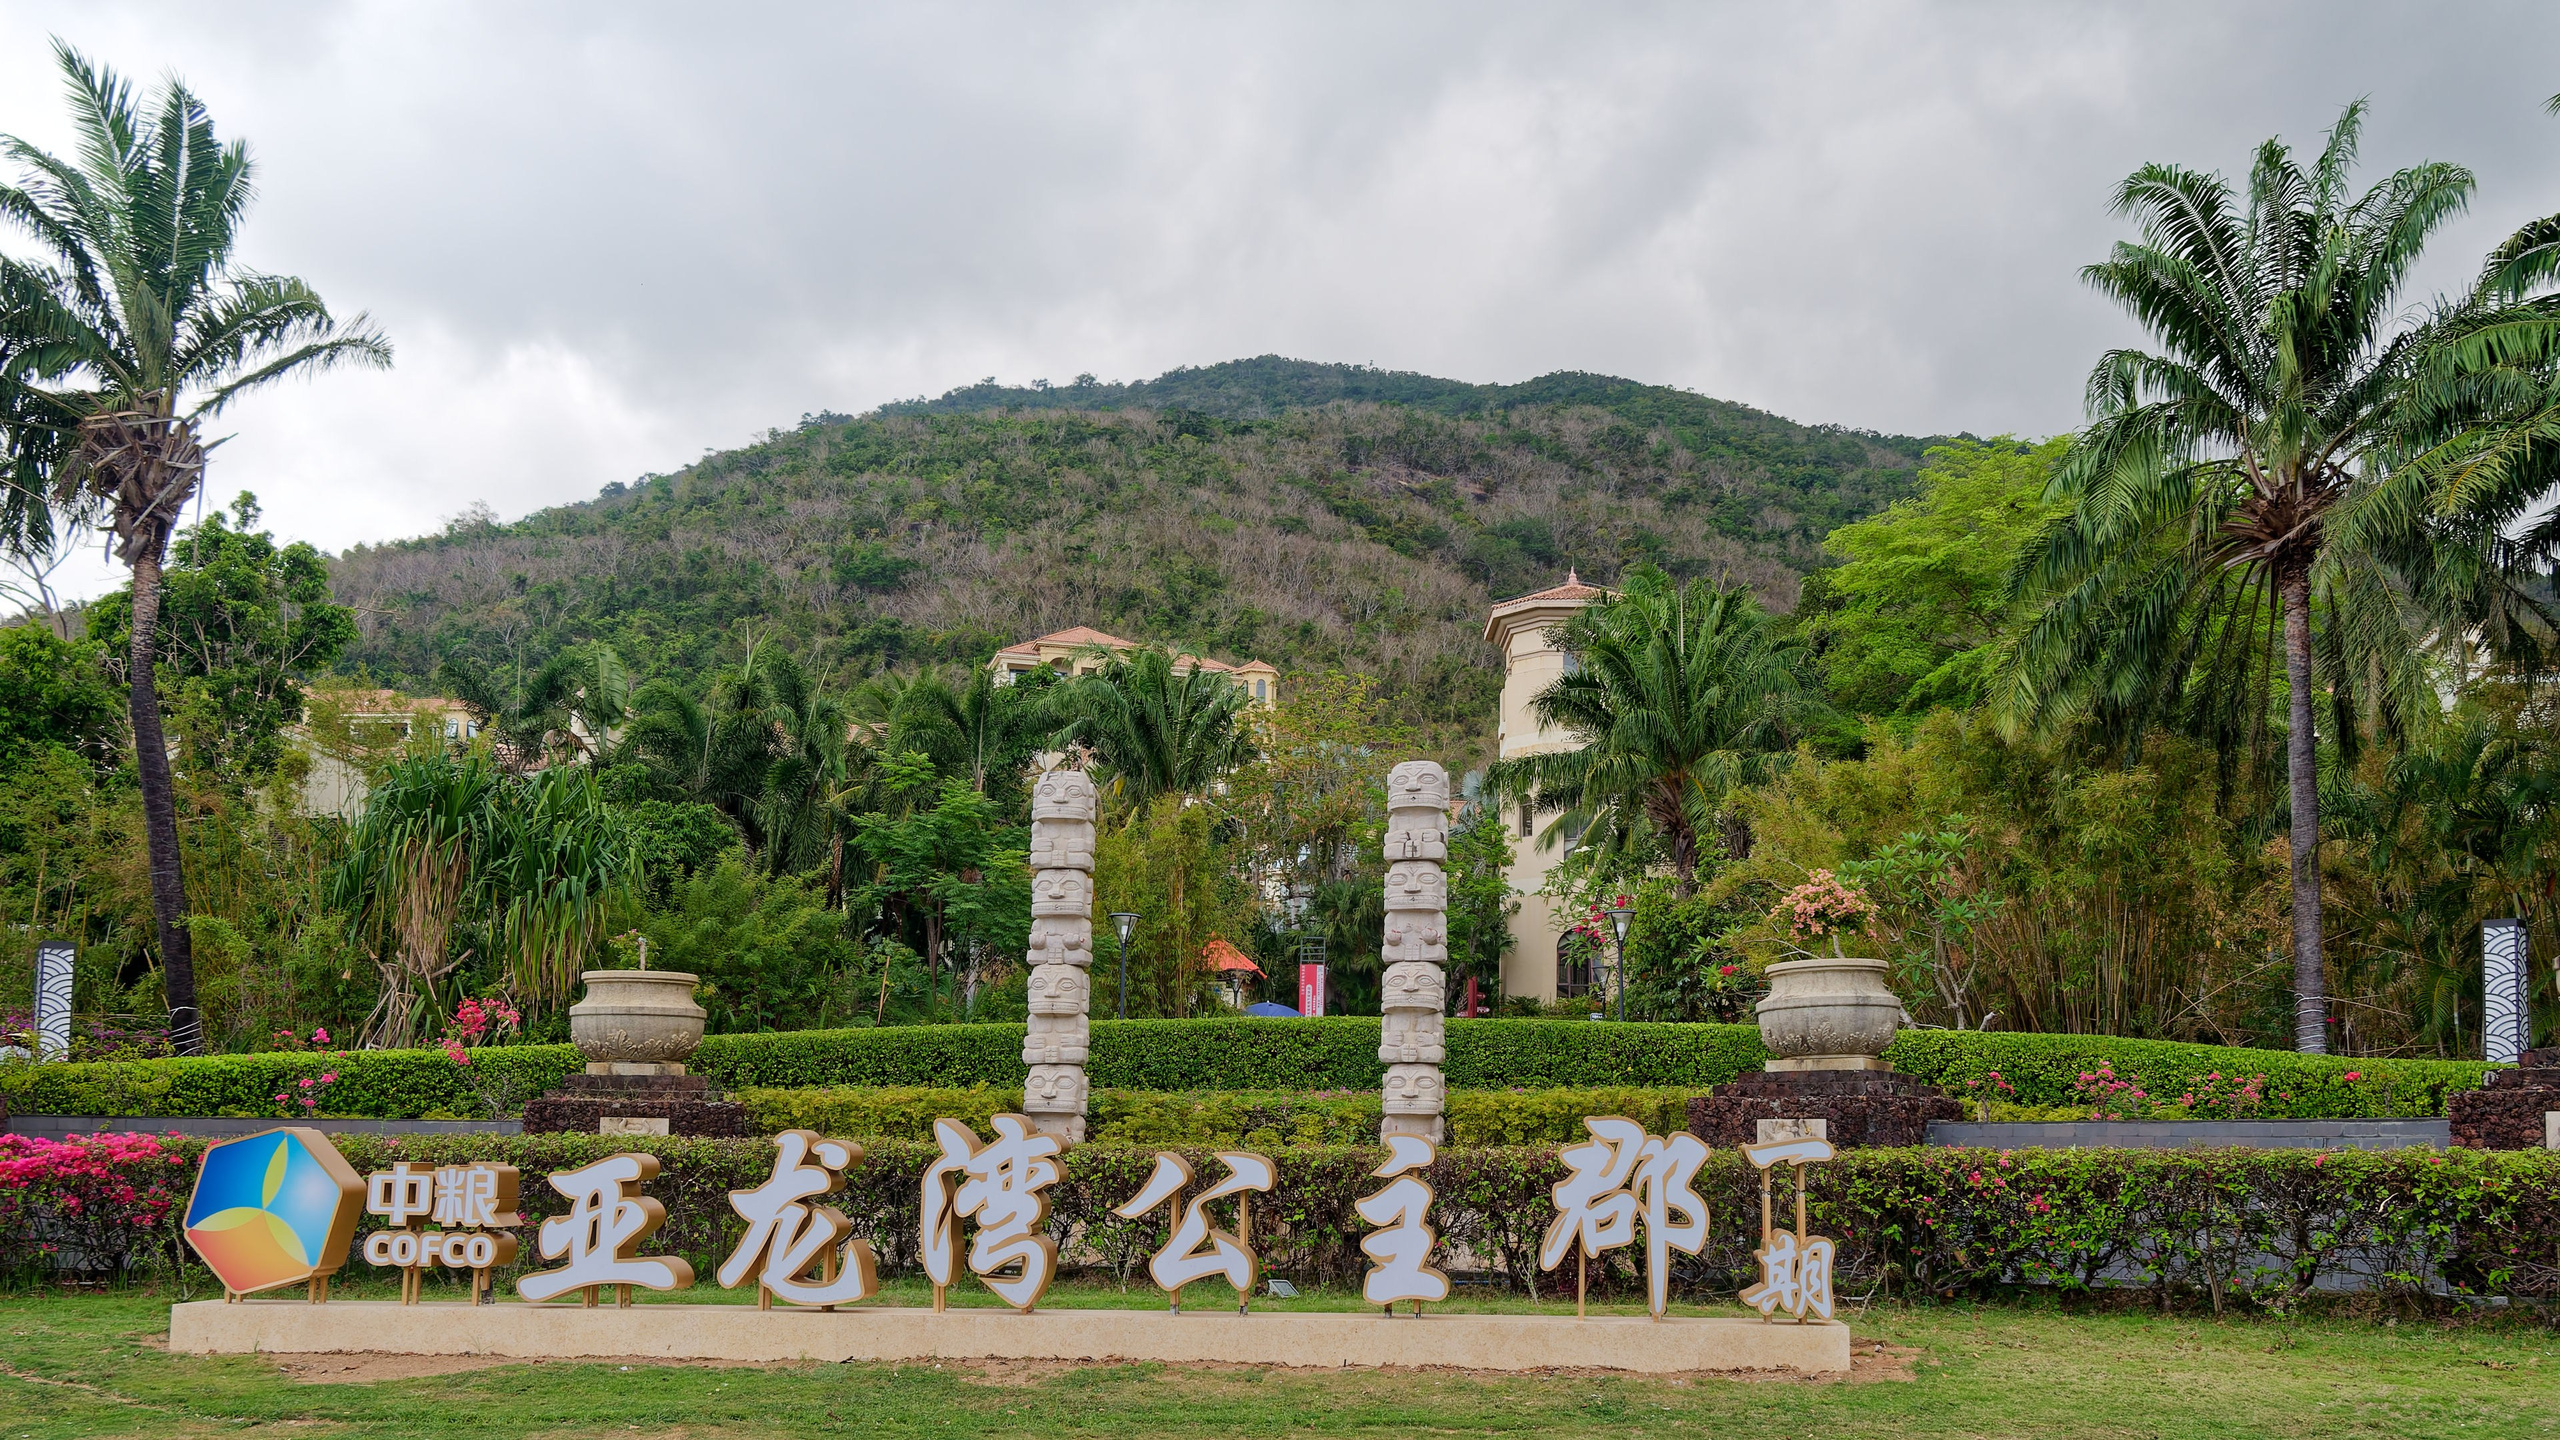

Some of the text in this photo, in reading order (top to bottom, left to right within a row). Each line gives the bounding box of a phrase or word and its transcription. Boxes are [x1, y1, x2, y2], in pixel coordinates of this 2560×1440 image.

[368, 1163, 500, 1226] 中粮
[517, 1114, 1710, 1318] 亚龙湾公主郡
[364, 1231, 496, 1268] COFCO
